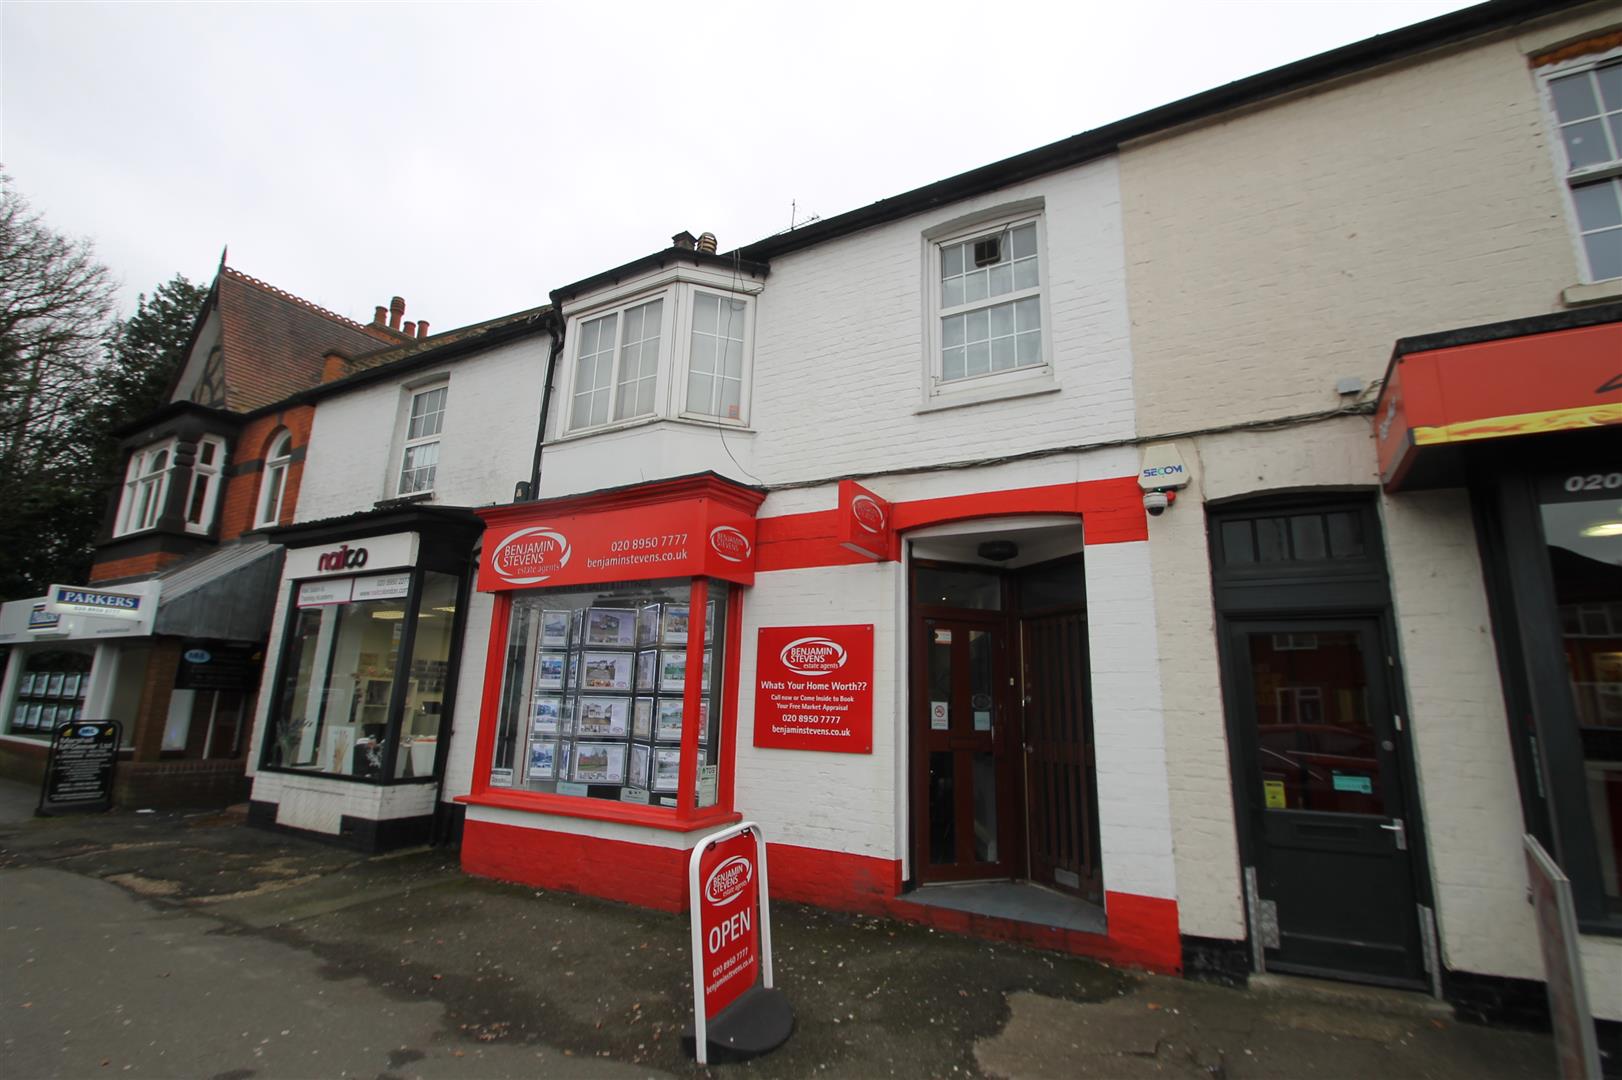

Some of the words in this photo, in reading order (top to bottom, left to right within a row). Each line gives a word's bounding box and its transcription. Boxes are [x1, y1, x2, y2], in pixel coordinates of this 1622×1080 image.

[1143, 464, 1183, 477] SECOM
[1565, 473, 1622, 491] 020
[504, 540, 555, 556] BENJAMIN
[611, 541, 630, 552] 020
[632, 537, 658, 550] 8950
[661, 534, 688, 546] 7777
[503, 552, 544, 568] STEVENS
[587, 549, 687, 569] benjaminstevens.co.uk
[517, 566, 536, 575] estate
[538, 563, 560, 574] agents
[64, 591, 134, 608] PARKERS
[791, 647, 833, 656] BENJAMIN
[791, 655, 825, 663] STEVENS
[761, 681, 785, 690] Whats
[787, 681, 805, 691] Your
[806, 681, 829, 691] Home
[831, 682, 868, 691] Worth??
[801, 703, 821, 711] Market
[822, 704, 849, 712] Appraisal
[782, 714, 797, 722] 020
[799, 715, 819, 723] 8950
[820, 716, 841, 724] 7777
[772, 725, 851, 737] benjaminstevens.co.uk
[713, 863, 743, 888] BENJAMIN
[713, 874, 738, 896] STEVENS
[709, 907, 751, 954] OPEN
[713, 964, 724, 978] 020
[724, 955, 736, 971] 8950
[736, 946, 748, 961] 7777
[706, 954, 754, 995] benjaminstevens.co.uk
